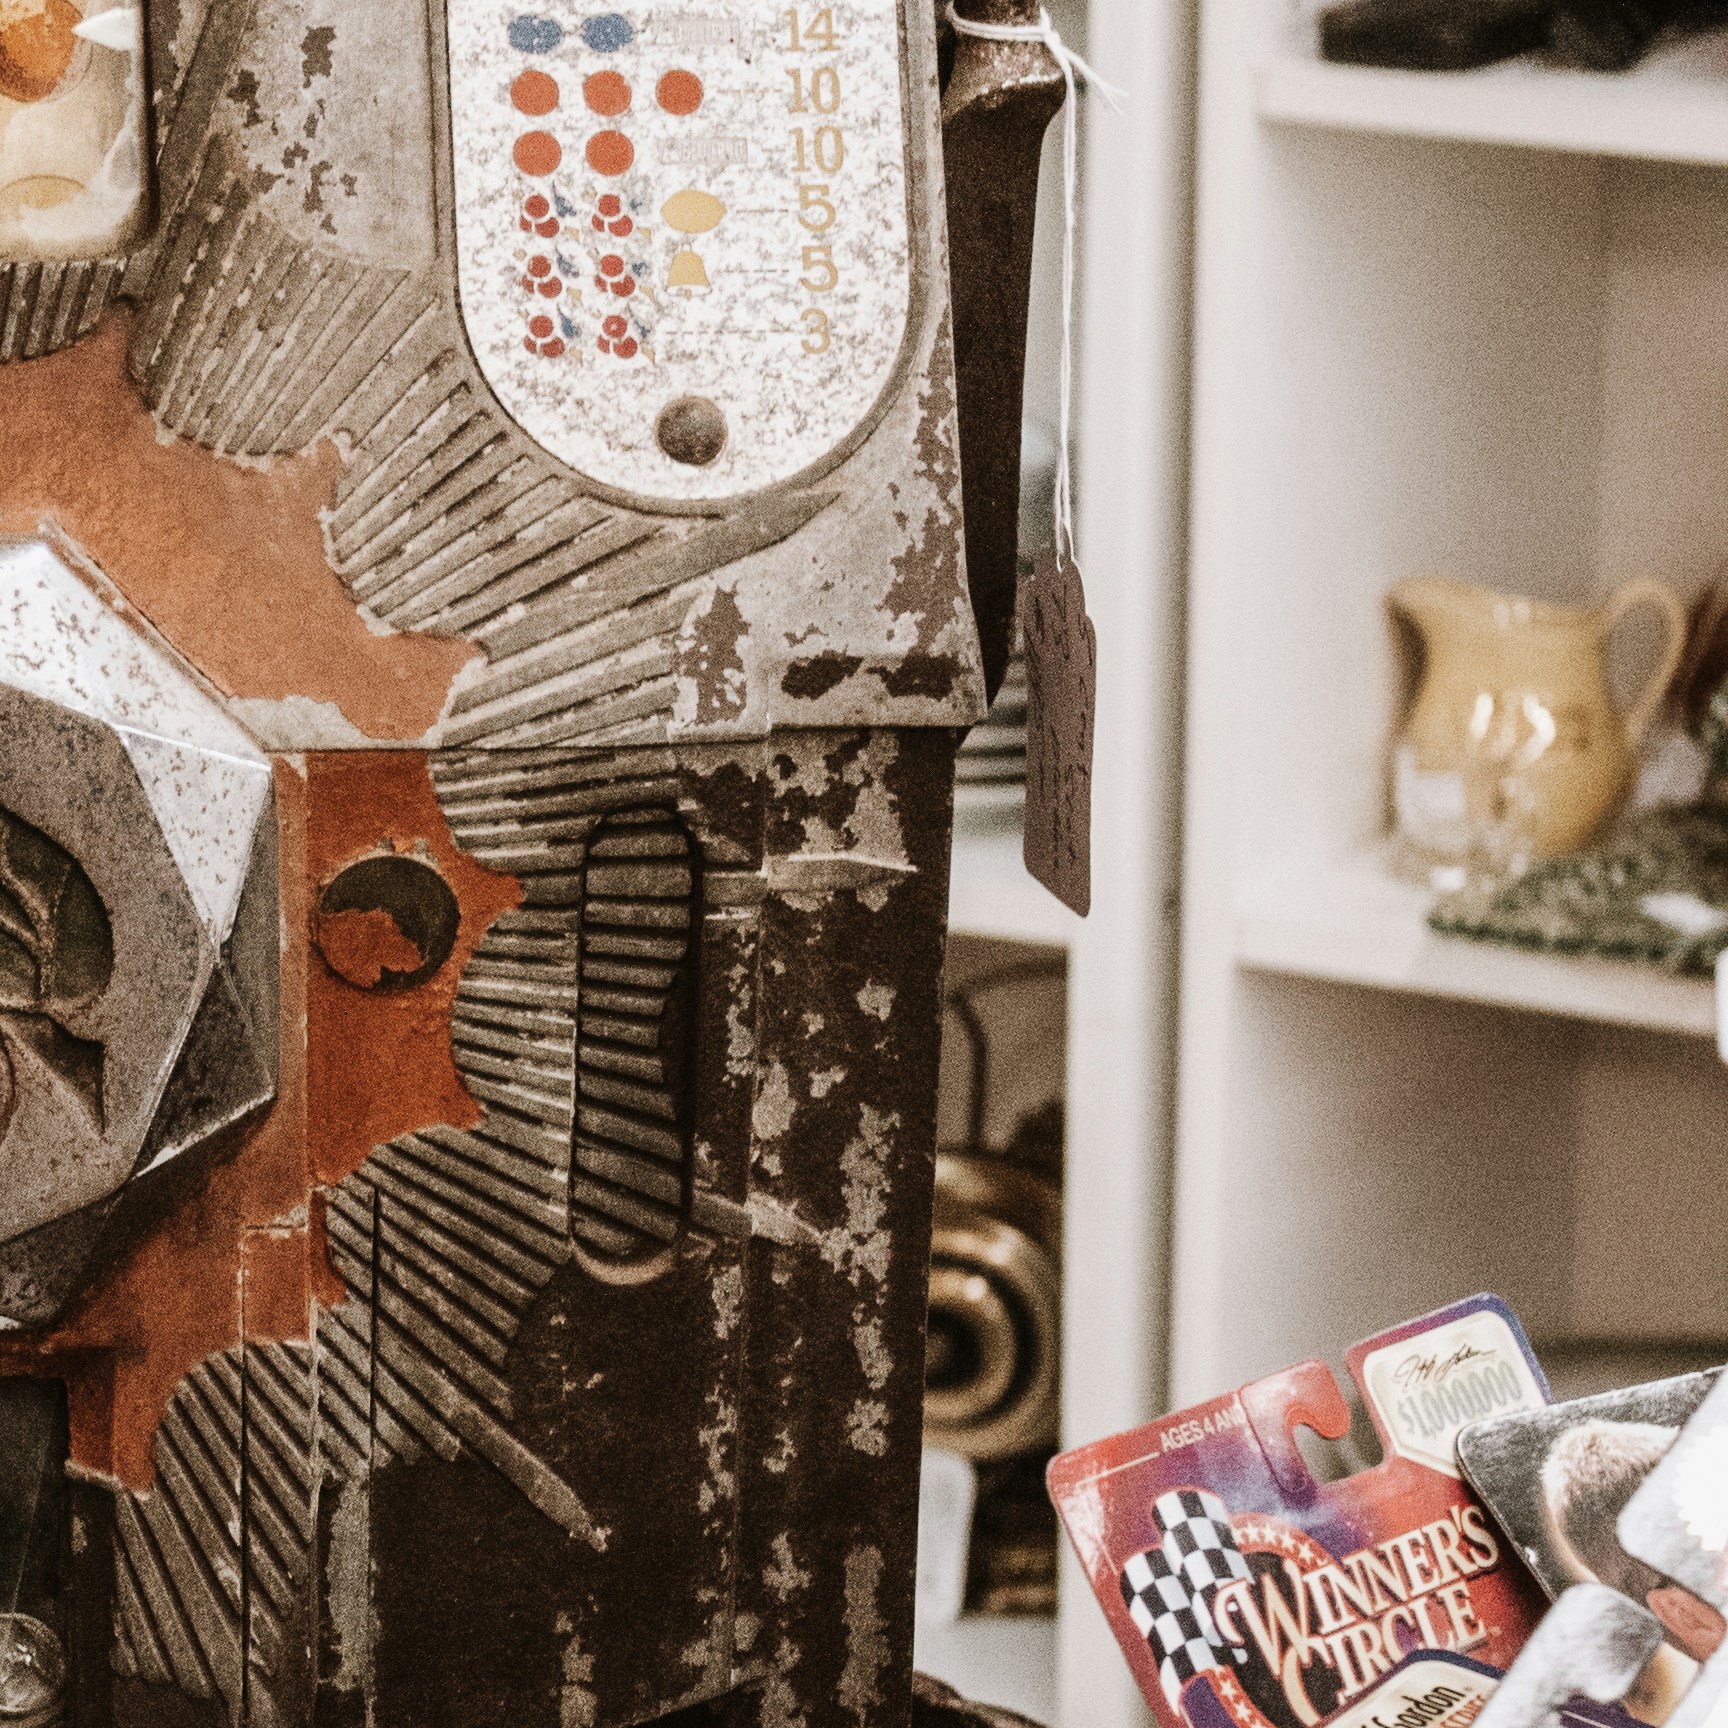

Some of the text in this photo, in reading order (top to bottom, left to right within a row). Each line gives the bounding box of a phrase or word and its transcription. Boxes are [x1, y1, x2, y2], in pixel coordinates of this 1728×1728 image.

[783, 7, 841, 52] 14
[785, 66, 842, 114] 10
[789, 125, 845, 173] 10
[798, 184, 837, 232] 5
[799, 246, 839, 292] 5
[800, 307, 832, 355] 3
[1159, 1419, 1205, 1452] AGES
[1213, 1505, 1500, 1675] WINNER'S
[1284, 1580, 1486, 1726] CIRCLE
